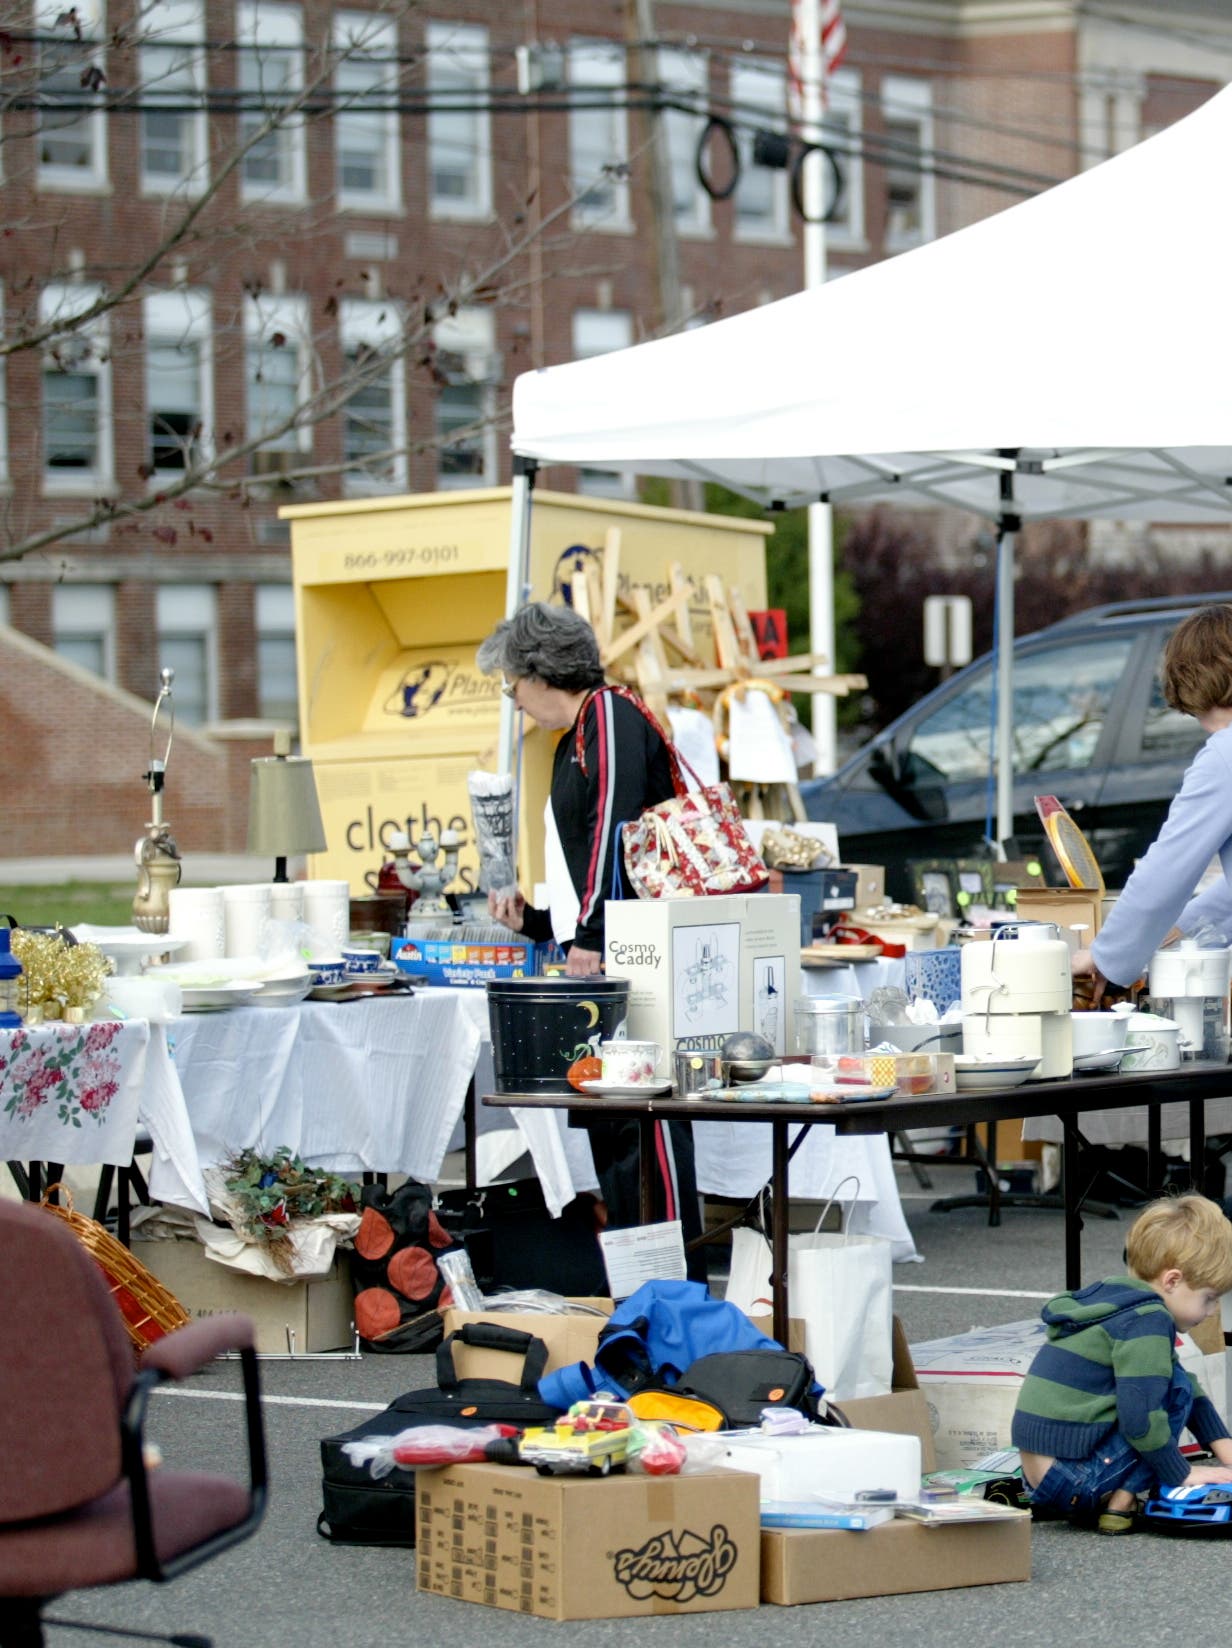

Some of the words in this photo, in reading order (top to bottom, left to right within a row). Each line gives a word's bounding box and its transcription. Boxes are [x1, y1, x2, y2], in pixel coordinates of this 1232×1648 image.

[343, 544, 459, 570] 866-997-0101
[346, 802, 478, 851] clothe
[608, 940, 656, 953] Cosmo
[614, 951, 662, 968] Caddy
